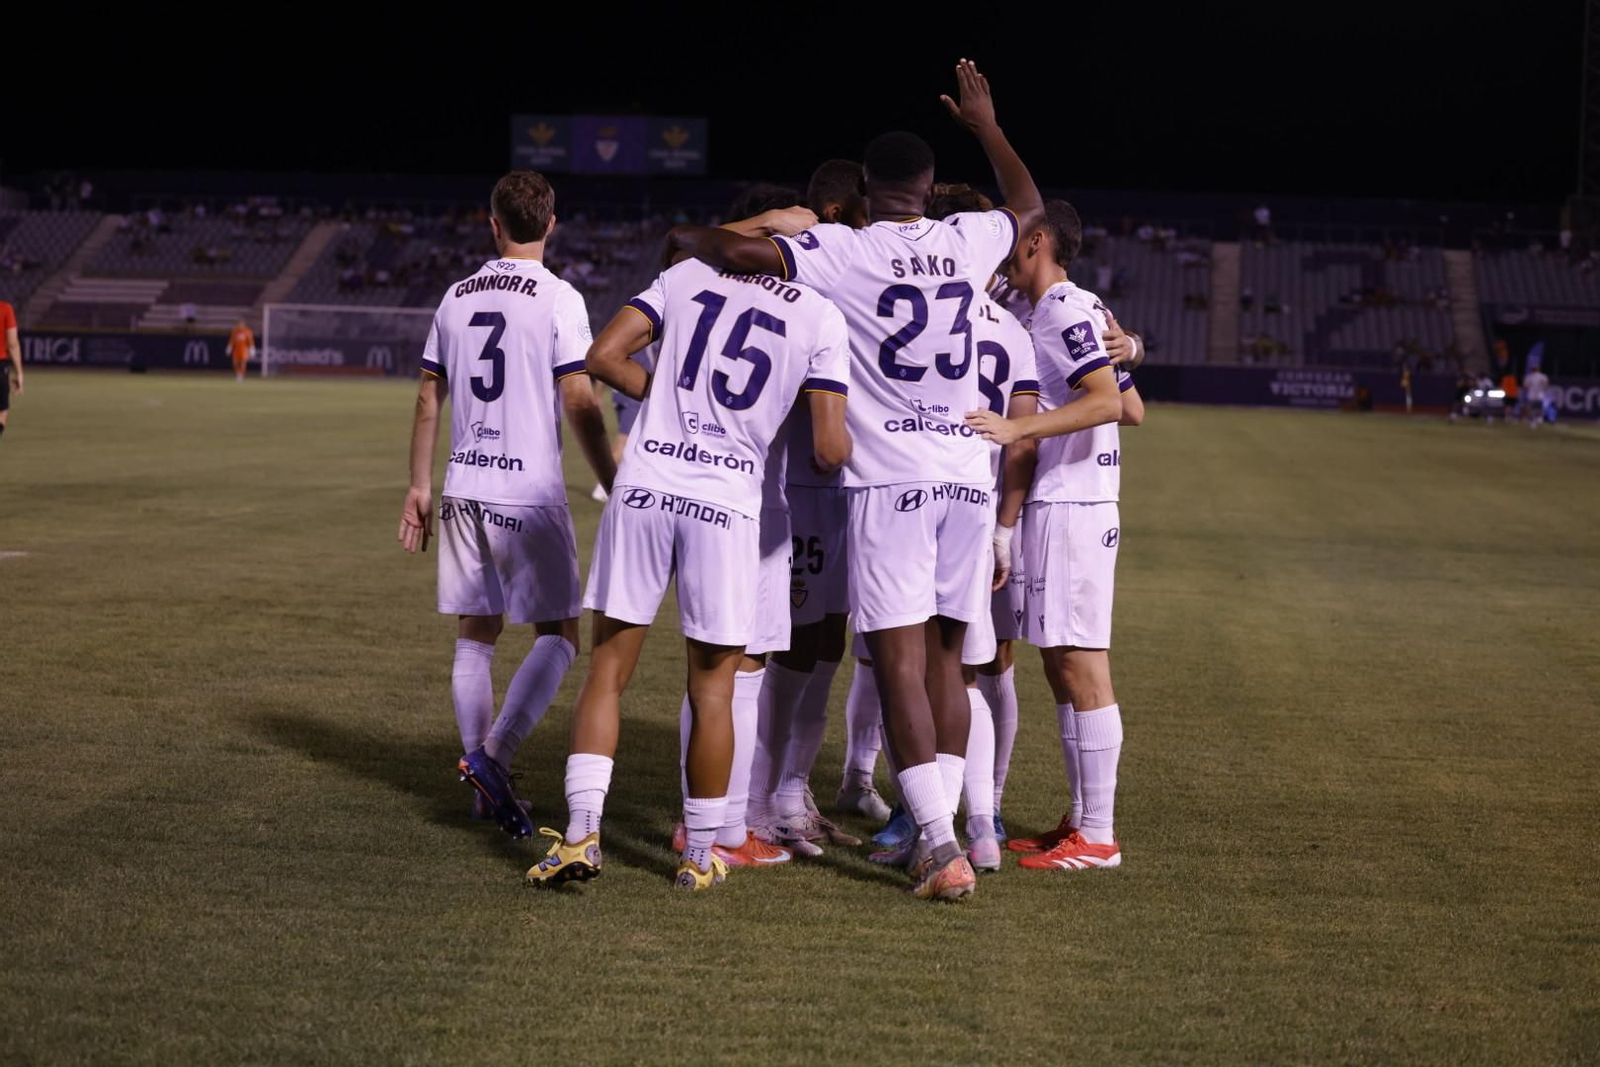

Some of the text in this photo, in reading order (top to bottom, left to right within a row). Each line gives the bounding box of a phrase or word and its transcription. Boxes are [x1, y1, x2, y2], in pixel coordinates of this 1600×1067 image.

[496, 261, 516, 271] 1922
[891, 254, 956, 278] SAKO
[455, 274, 537, 298] CONNOR R.
[877, 281, 974, 382] 23
[468, 311, 507, 403] 3
[677, 289, 787, 410] 15
[701, 423, 726, 435] clibo
[643, 439, 755, 475] calderón
